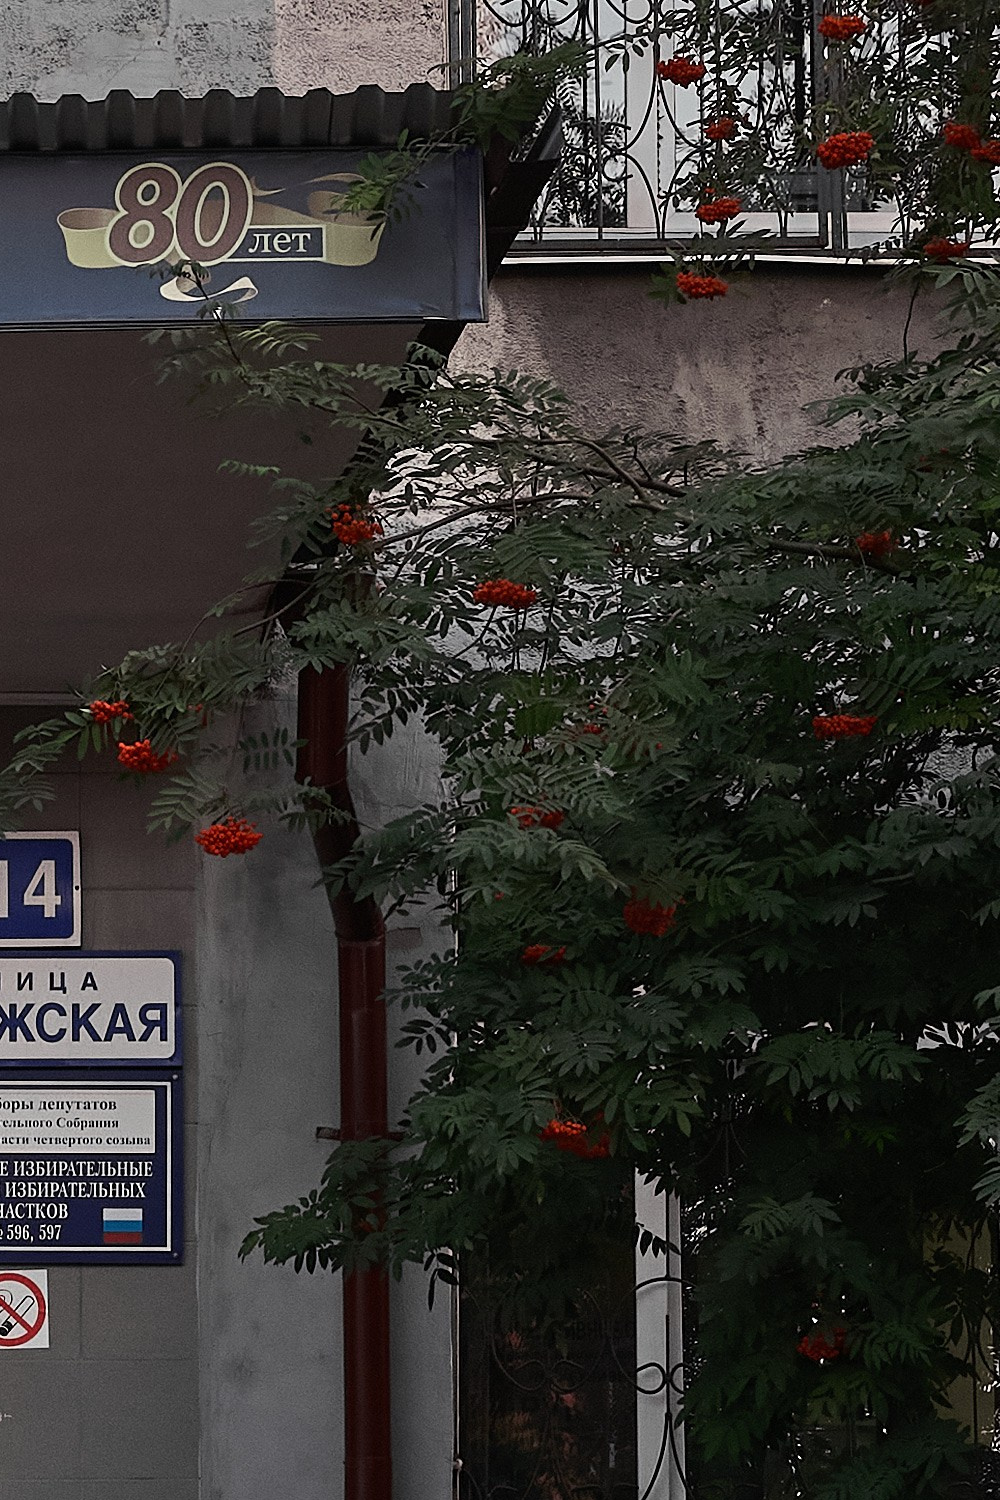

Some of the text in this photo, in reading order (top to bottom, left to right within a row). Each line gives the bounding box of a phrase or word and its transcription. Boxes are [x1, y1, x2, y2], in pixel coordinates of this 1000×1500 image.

[106, 162, 311, 267] 80 лет
[38, 1100, 117, 1114] депутатов
[56, 1116, 119, 1131] Собрания
[33, 1136, 103, 1148] четвертого
[106, 1137, 151, 1146] созыва
[13, 1160, 154, 1177] ИЗБИРАТЕЛЬНЫЕ
[5, 1181, 146, 1198] ИЗБИРАТЕЛЬНЫХ
[6, 1224, 34, 1243] 596,
[38, 1224, 62, 1241] 597
